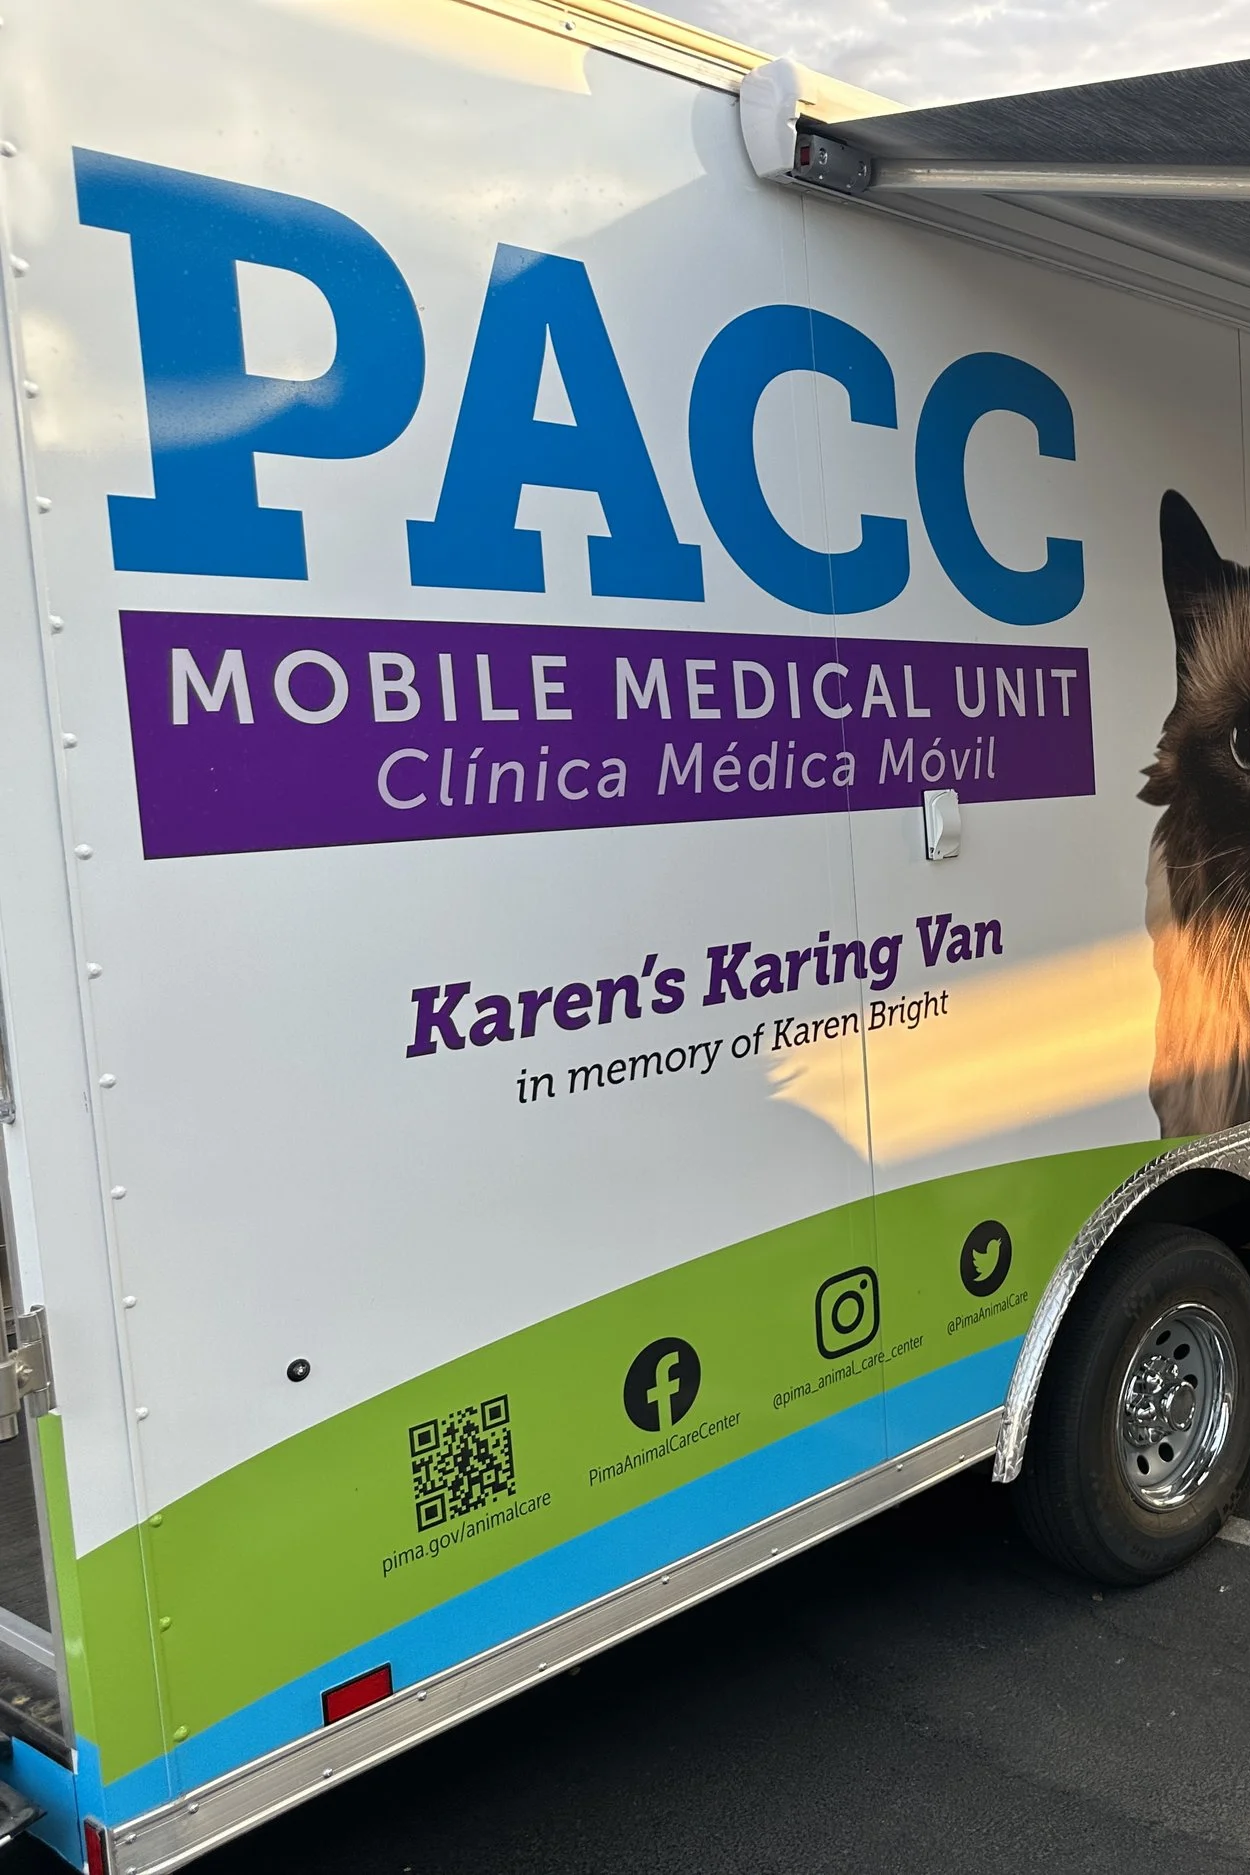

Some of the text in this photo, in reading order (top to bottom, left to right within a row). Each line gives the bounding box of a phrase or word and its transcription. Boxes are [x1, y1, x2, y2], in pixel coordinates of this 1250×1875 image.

[72, 147, 1085, 625] PACC
[169, 647, 1078, 725] MOBILE MEDICAL UNIT
[377, 735, 998, 809] Clínica Médica Móvil
[702, 930, 902, 1006] Karing
[914, 912, 1003, 967] Van
[516, 988, 949, 1103] in memory of Karen Bright
[947, 1289, 1029, 1336] @PimaAnimalCare
[772, 1333, 925, 1410] @pima_animal_care_center
[588, 1411, 741, 1487] PimaAnimalCareCenter
[382, 1492, 551, 1577] pima.gov/animalcare
